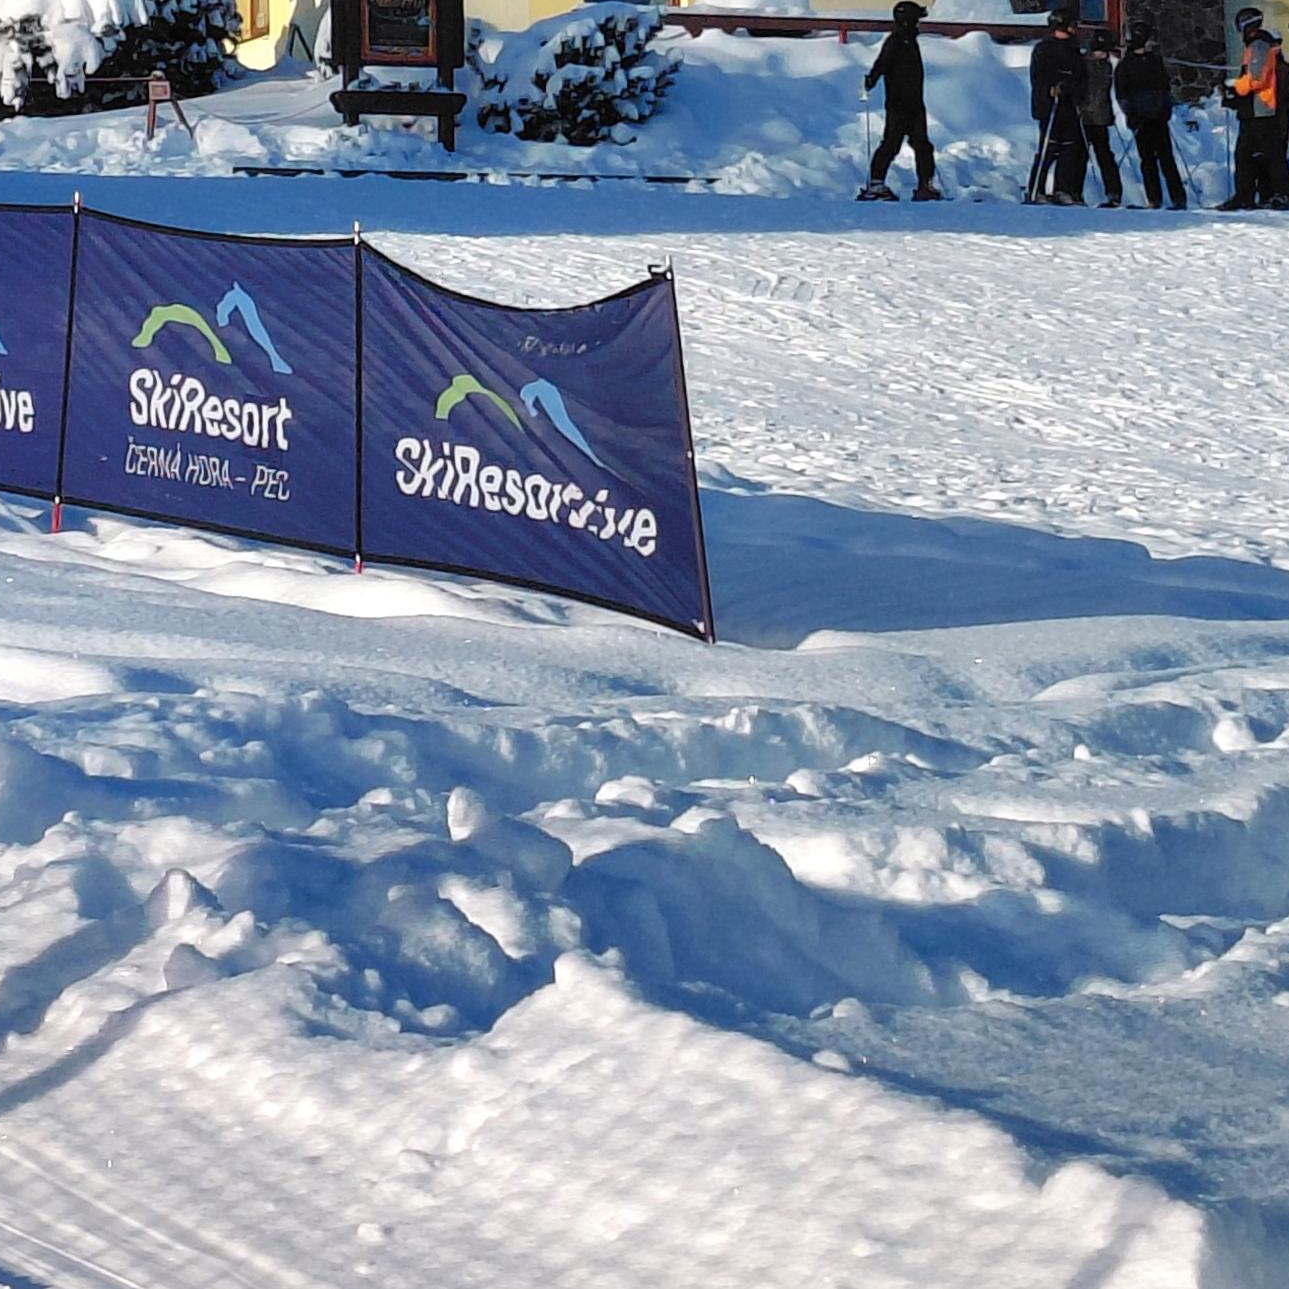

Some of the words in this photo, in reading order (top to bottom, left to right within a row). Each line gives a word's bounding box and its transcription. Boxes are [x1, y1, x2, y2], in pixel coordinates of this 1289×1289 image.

[129, 368, 293, 451] SkiResort
[125, 436, 181, 481] ČERNÁ
[185, 453, 234, 490] HORA
[250, 465, 290, 500] PEC
